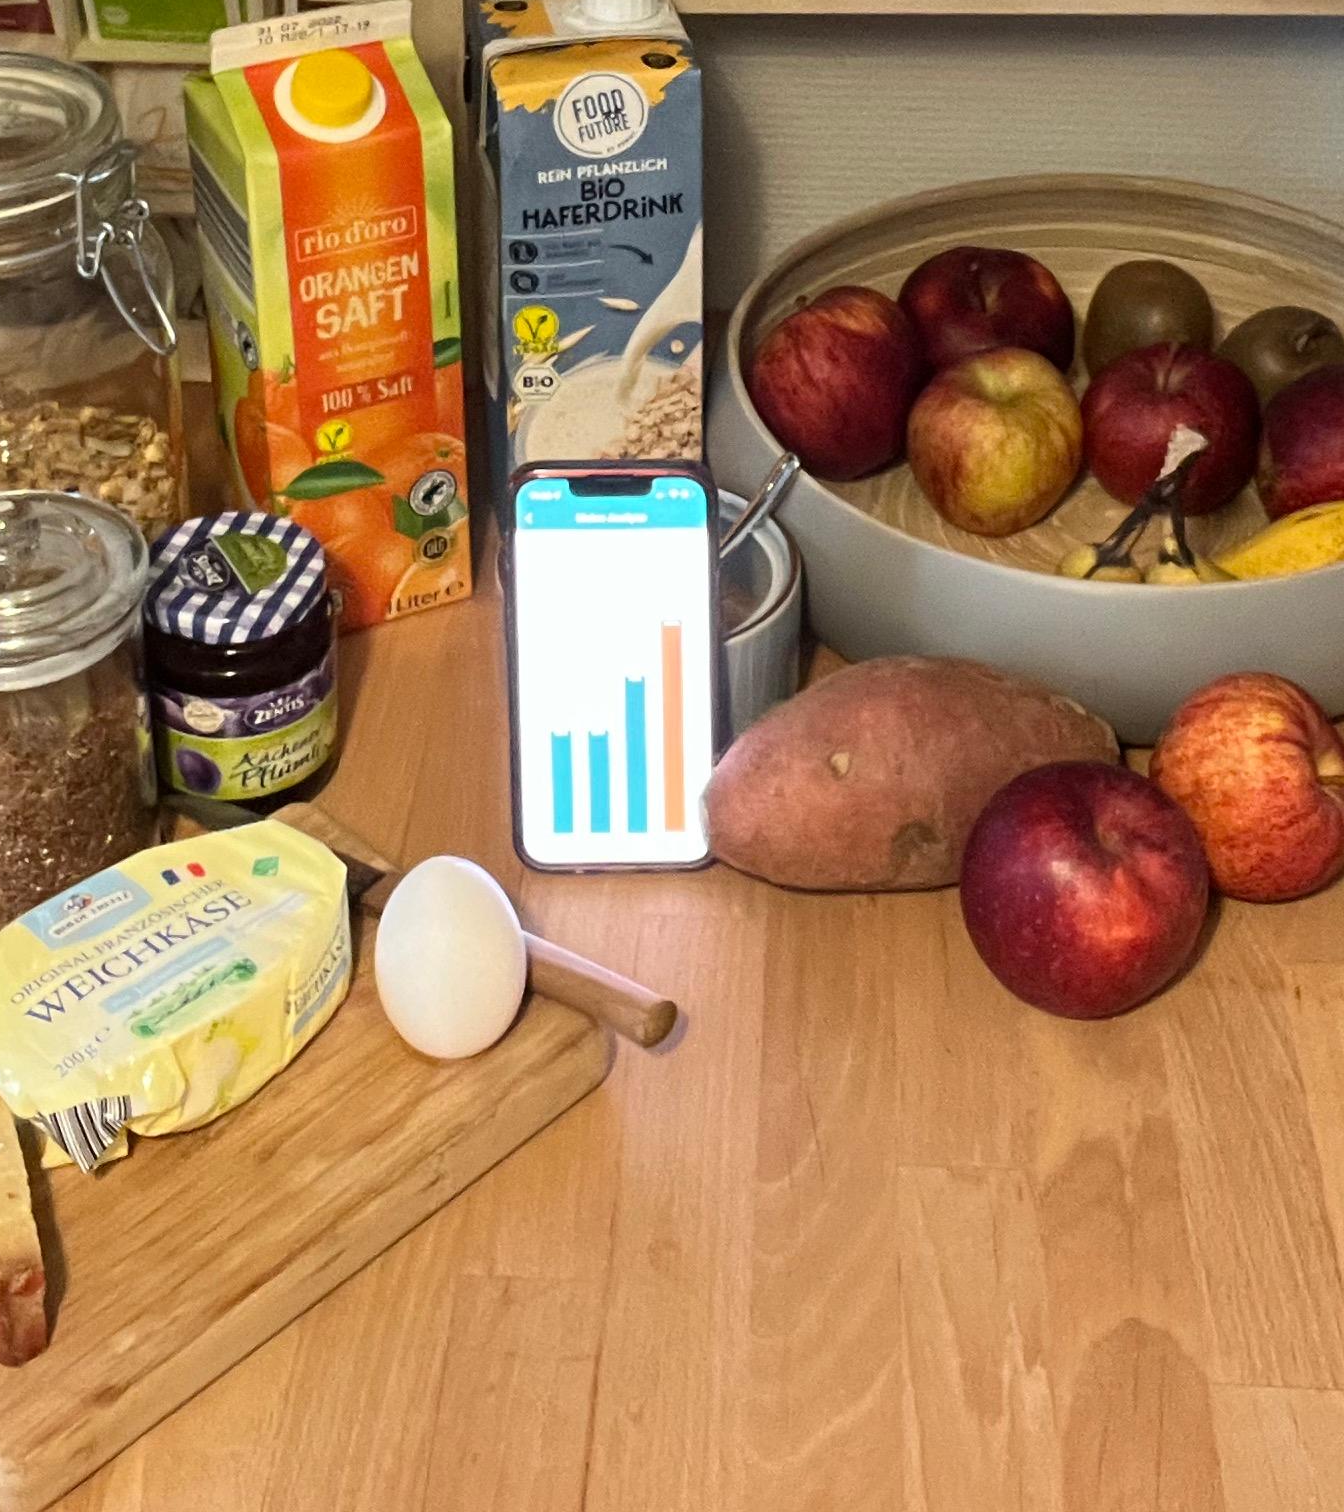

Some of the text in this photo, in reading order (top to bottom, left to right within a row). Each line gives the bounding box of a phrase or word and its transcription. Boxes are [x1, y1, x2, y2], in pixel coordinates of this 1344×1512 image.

[572, 88, 625, 124] FOOD
[578, 112, 631, 143] FUTURE
[303, 230, 340, 255] rio
[299, 250, 420, 303] ORANGEN
[316, 284, 409, 339] SAFT
[321, 388, 354, 413] 100
[377, 376, 414, 399] Saft
[254, 694, 305, 725] ZENTIS
[10, 948, 97, 1004] ORIGINAL
[97, 879, 227, 956] FRANZÖSISCHER
[25, 890, 252, 1023] WEICHKÄSE
[53, 1050, 85, 1078] 200
